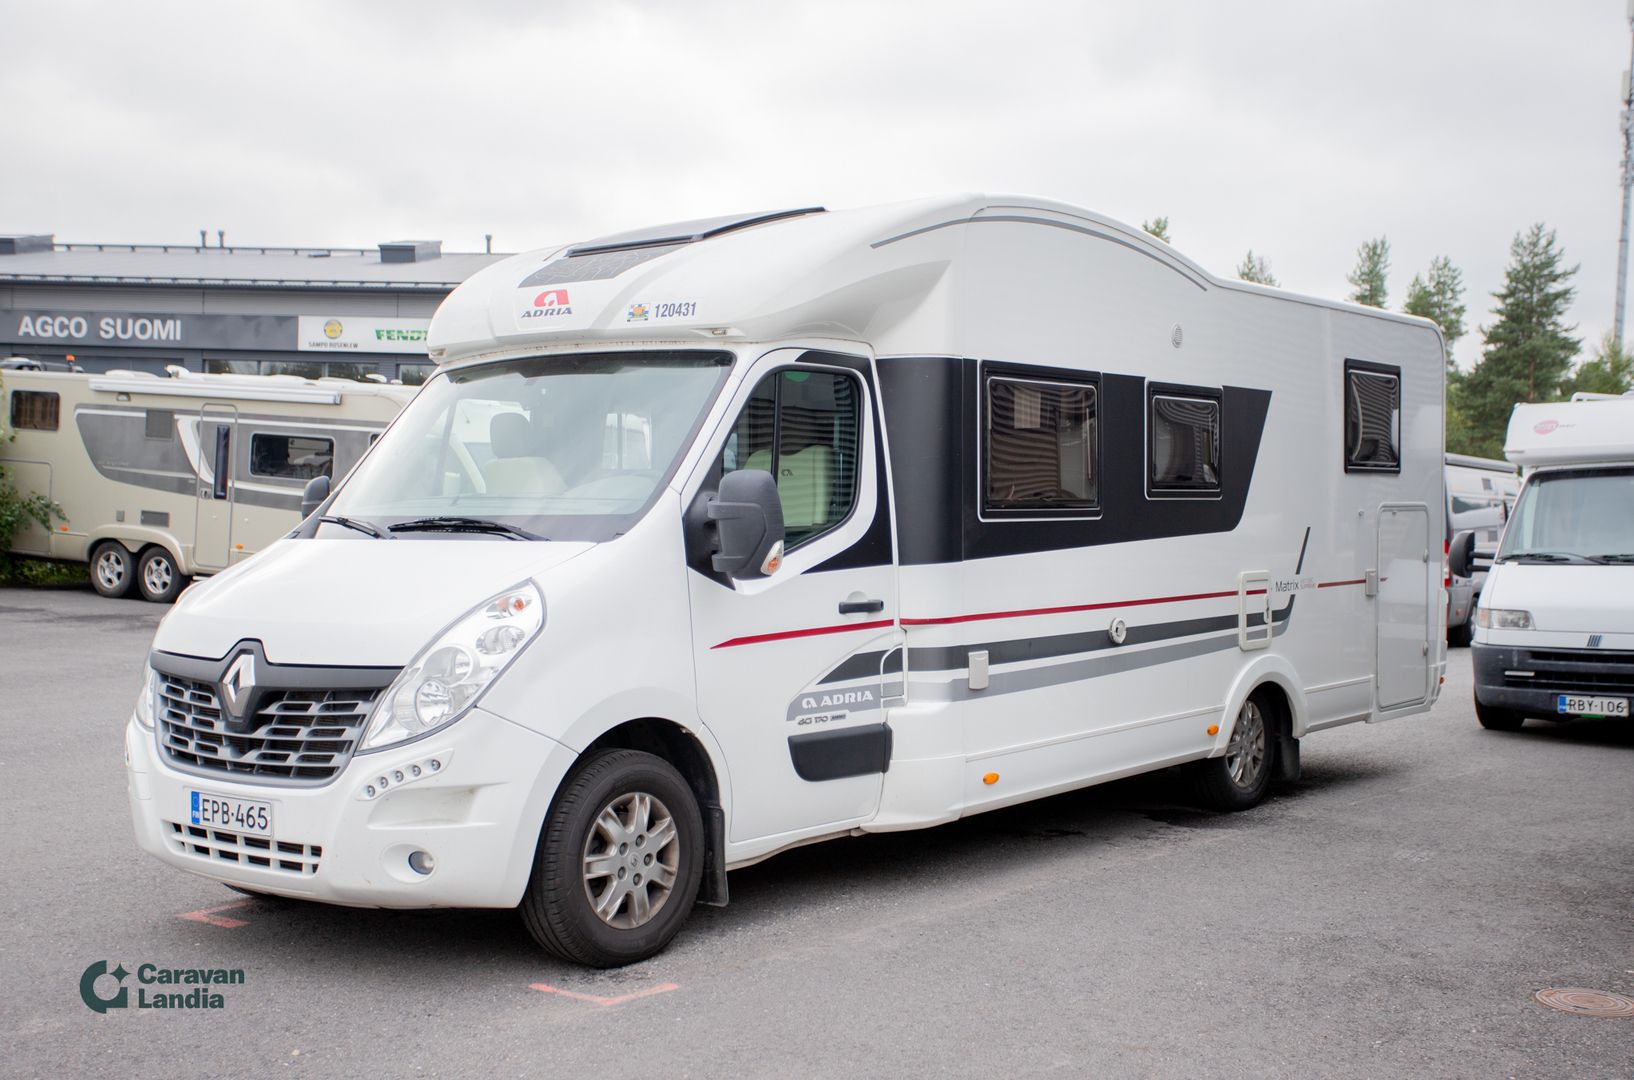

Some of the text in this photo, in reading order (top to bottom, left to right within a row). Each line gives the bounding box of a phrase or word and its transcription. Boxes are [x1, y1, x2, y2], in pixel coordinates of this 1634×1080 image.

[520, 307, 572, 318] ADRIA
[655, 301, 697, 318] 120431
[18, 315, 182, 341] AGCO SUOMI
[1275, 579, 1299, 592] Matrix
[820, 690, 874, 707] ADRIA
[1568, 699, 1625, 713] RBY-106
[202, 798, 269, 830] EPB-465
